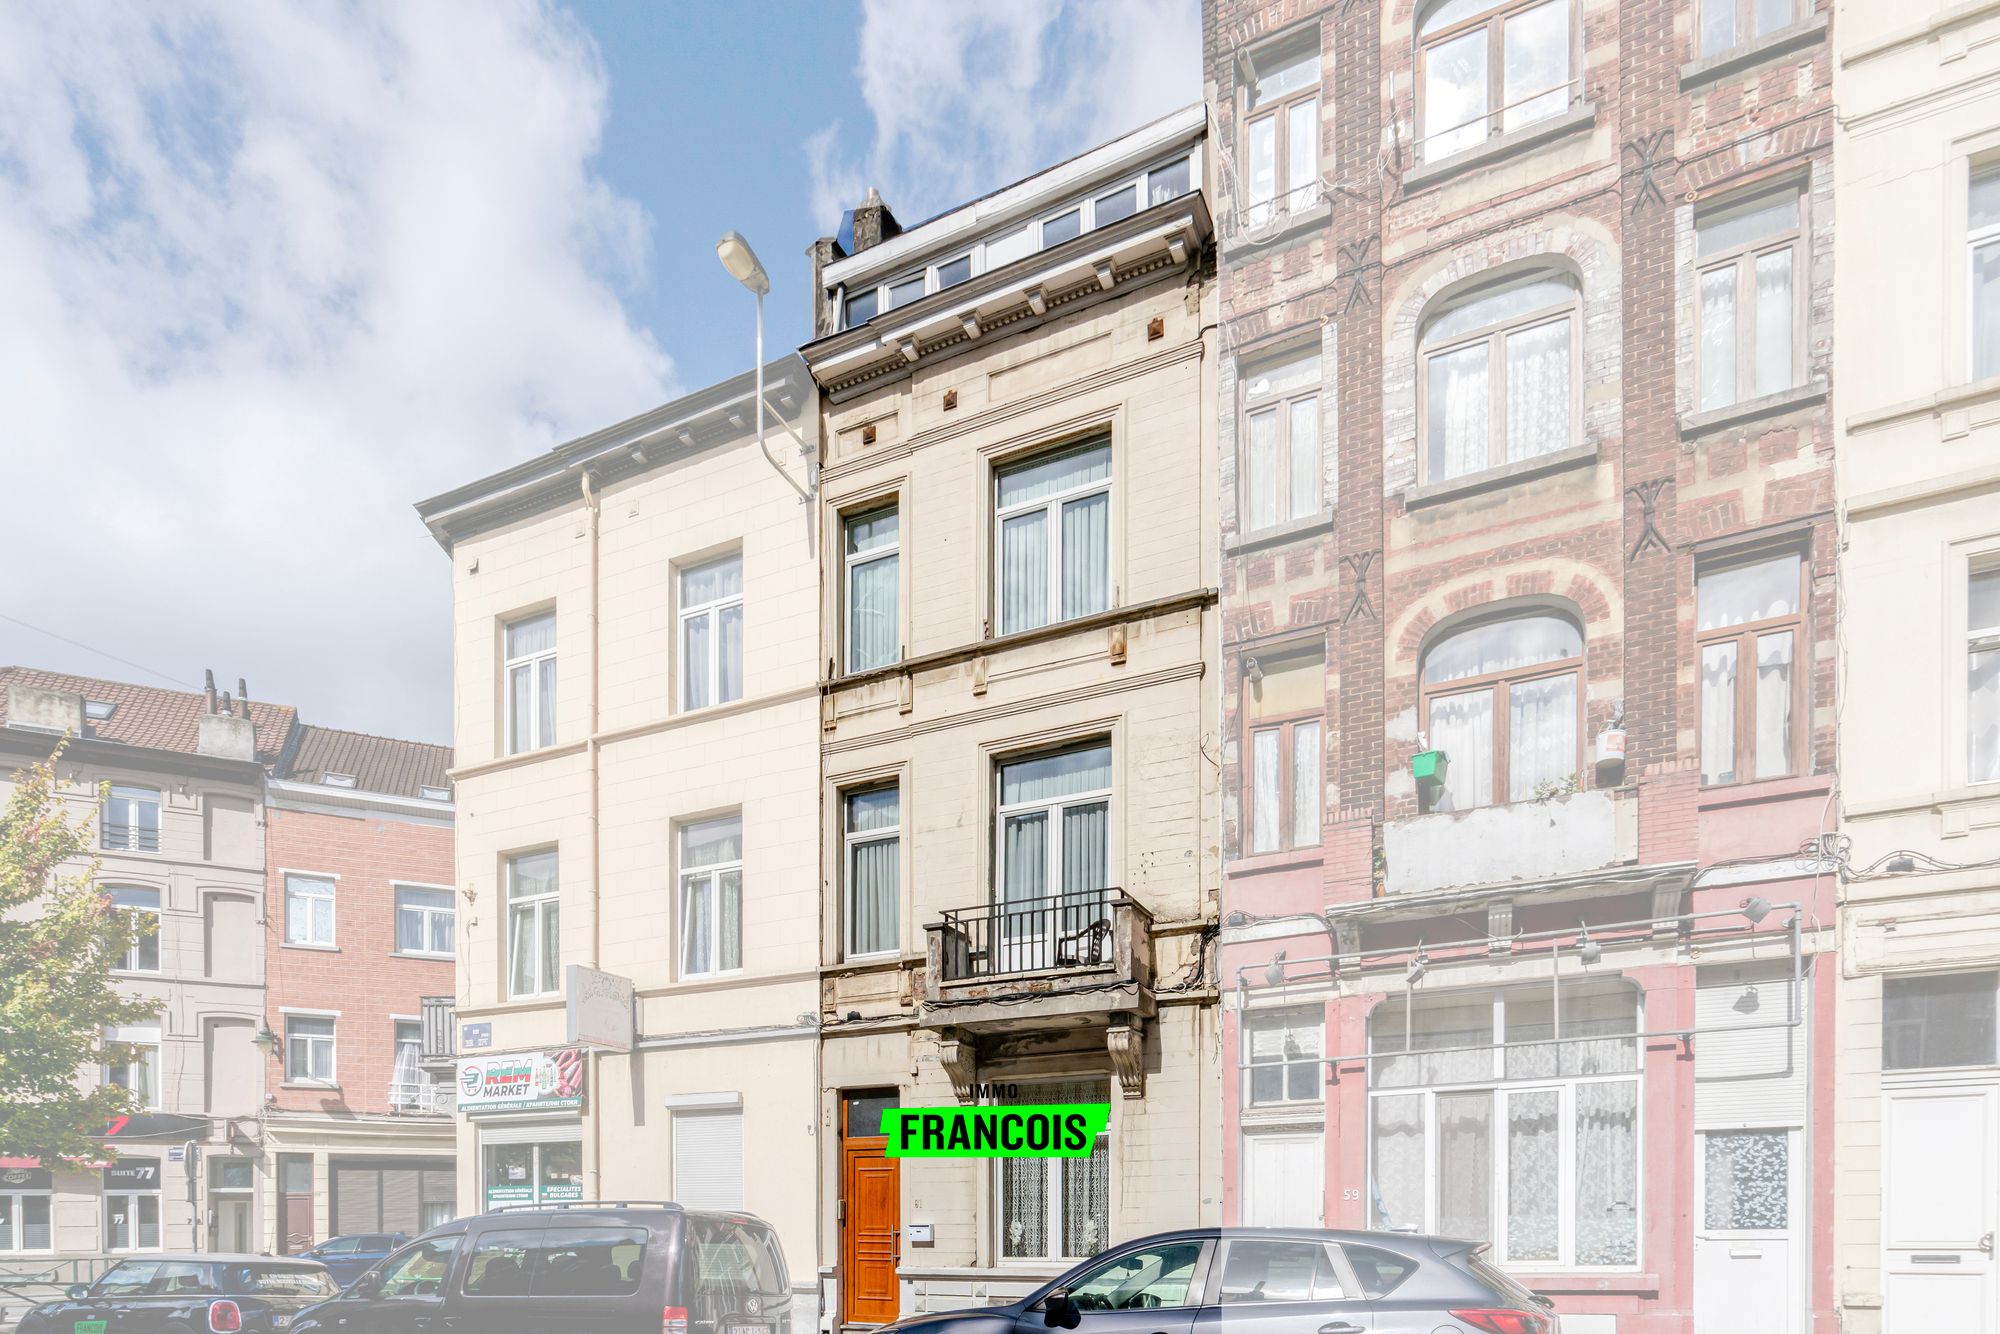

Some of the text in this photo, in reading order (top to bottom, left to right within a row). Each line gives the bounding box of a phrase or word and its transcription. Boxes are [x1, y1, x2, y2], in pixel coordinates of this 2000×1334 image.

[485, 1058, 533, 1085] REM
[483, 1084, 530, 1098] MARKET
[461, 1103, 497, 1112] ALIMENTATION
[135, 1167, 155, 1179] 77
[1343, 1189, 1360, 1201] 59
